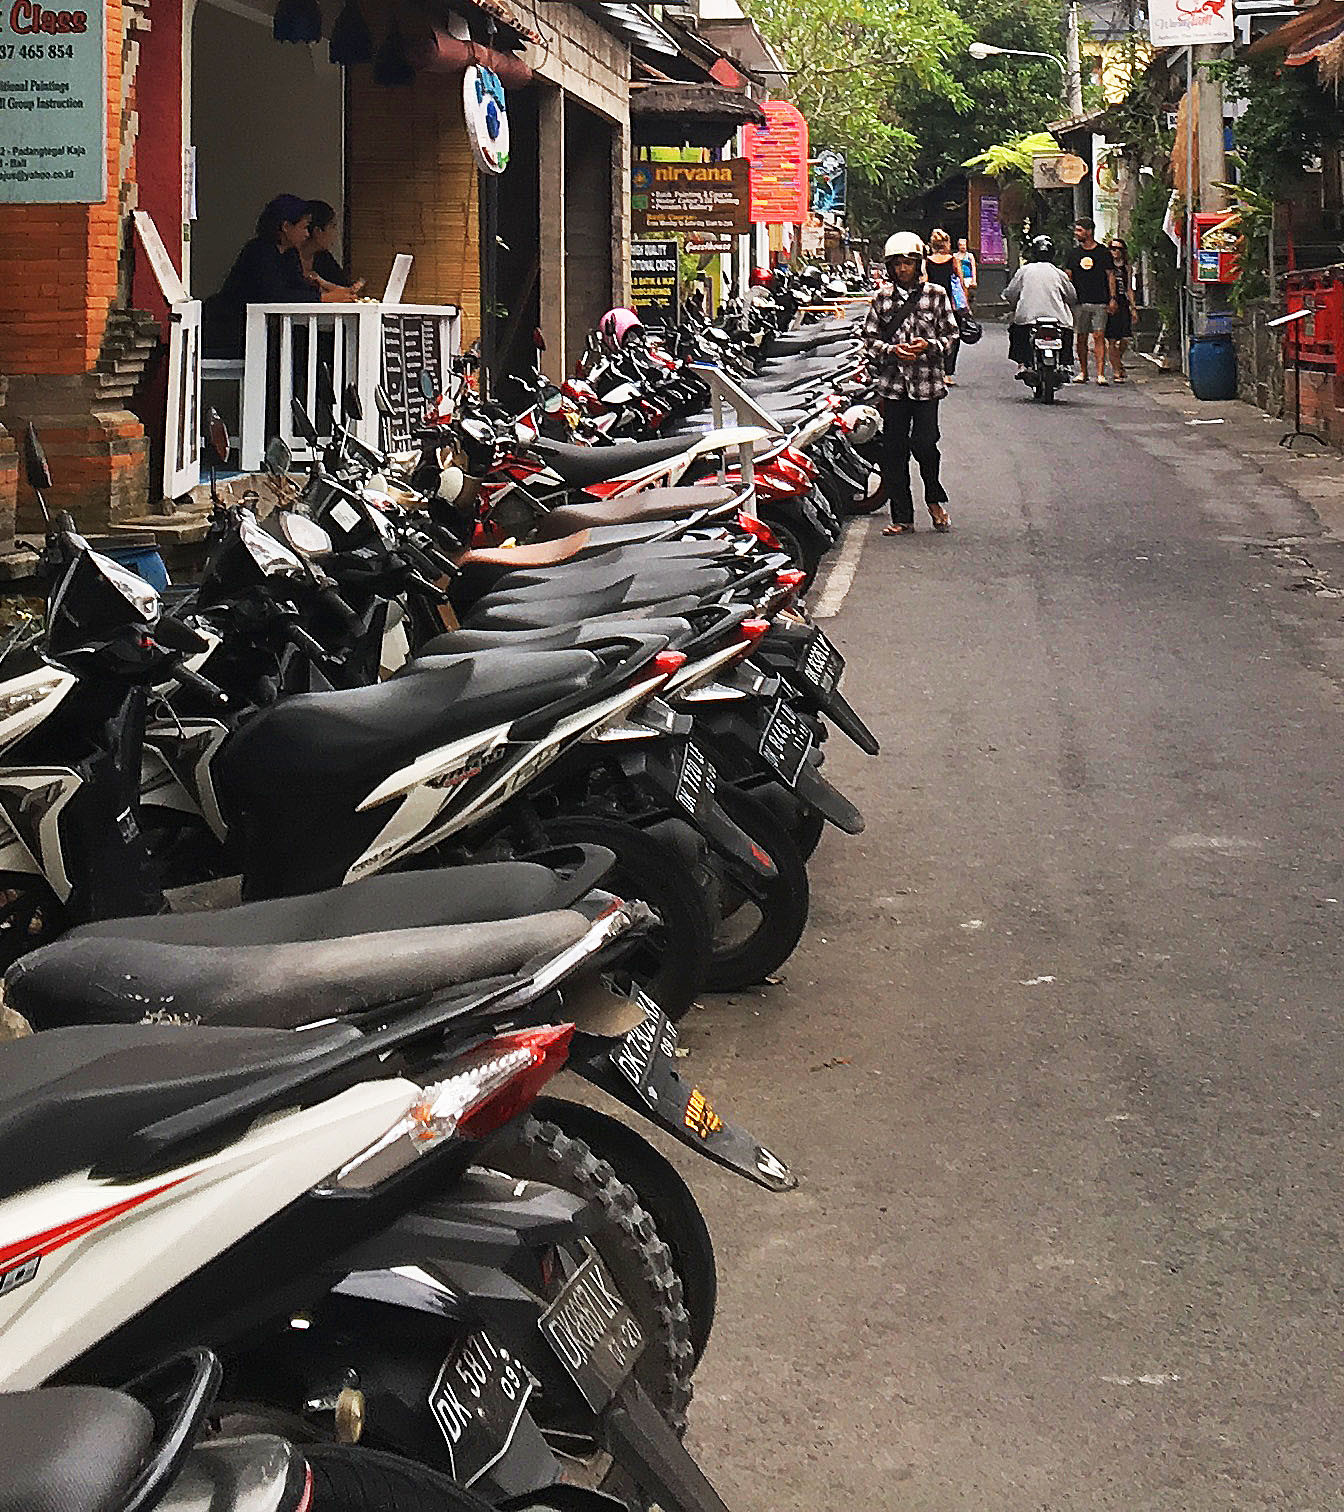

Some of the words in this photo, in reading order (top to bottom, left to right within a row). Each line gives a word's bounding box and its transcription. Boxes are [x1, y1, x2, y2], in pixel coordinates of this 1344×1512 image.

[19, 45, 44, 60] 465
[47, 44, 74, 60] 854
[8, 97, 35, 111] Group
[37, 97, 84, 109] Instruction
[656, 166, 732, 182] nirvana
[619, 1044, 646, 1085] DK
[437, 1381, 473, 1443] DK
